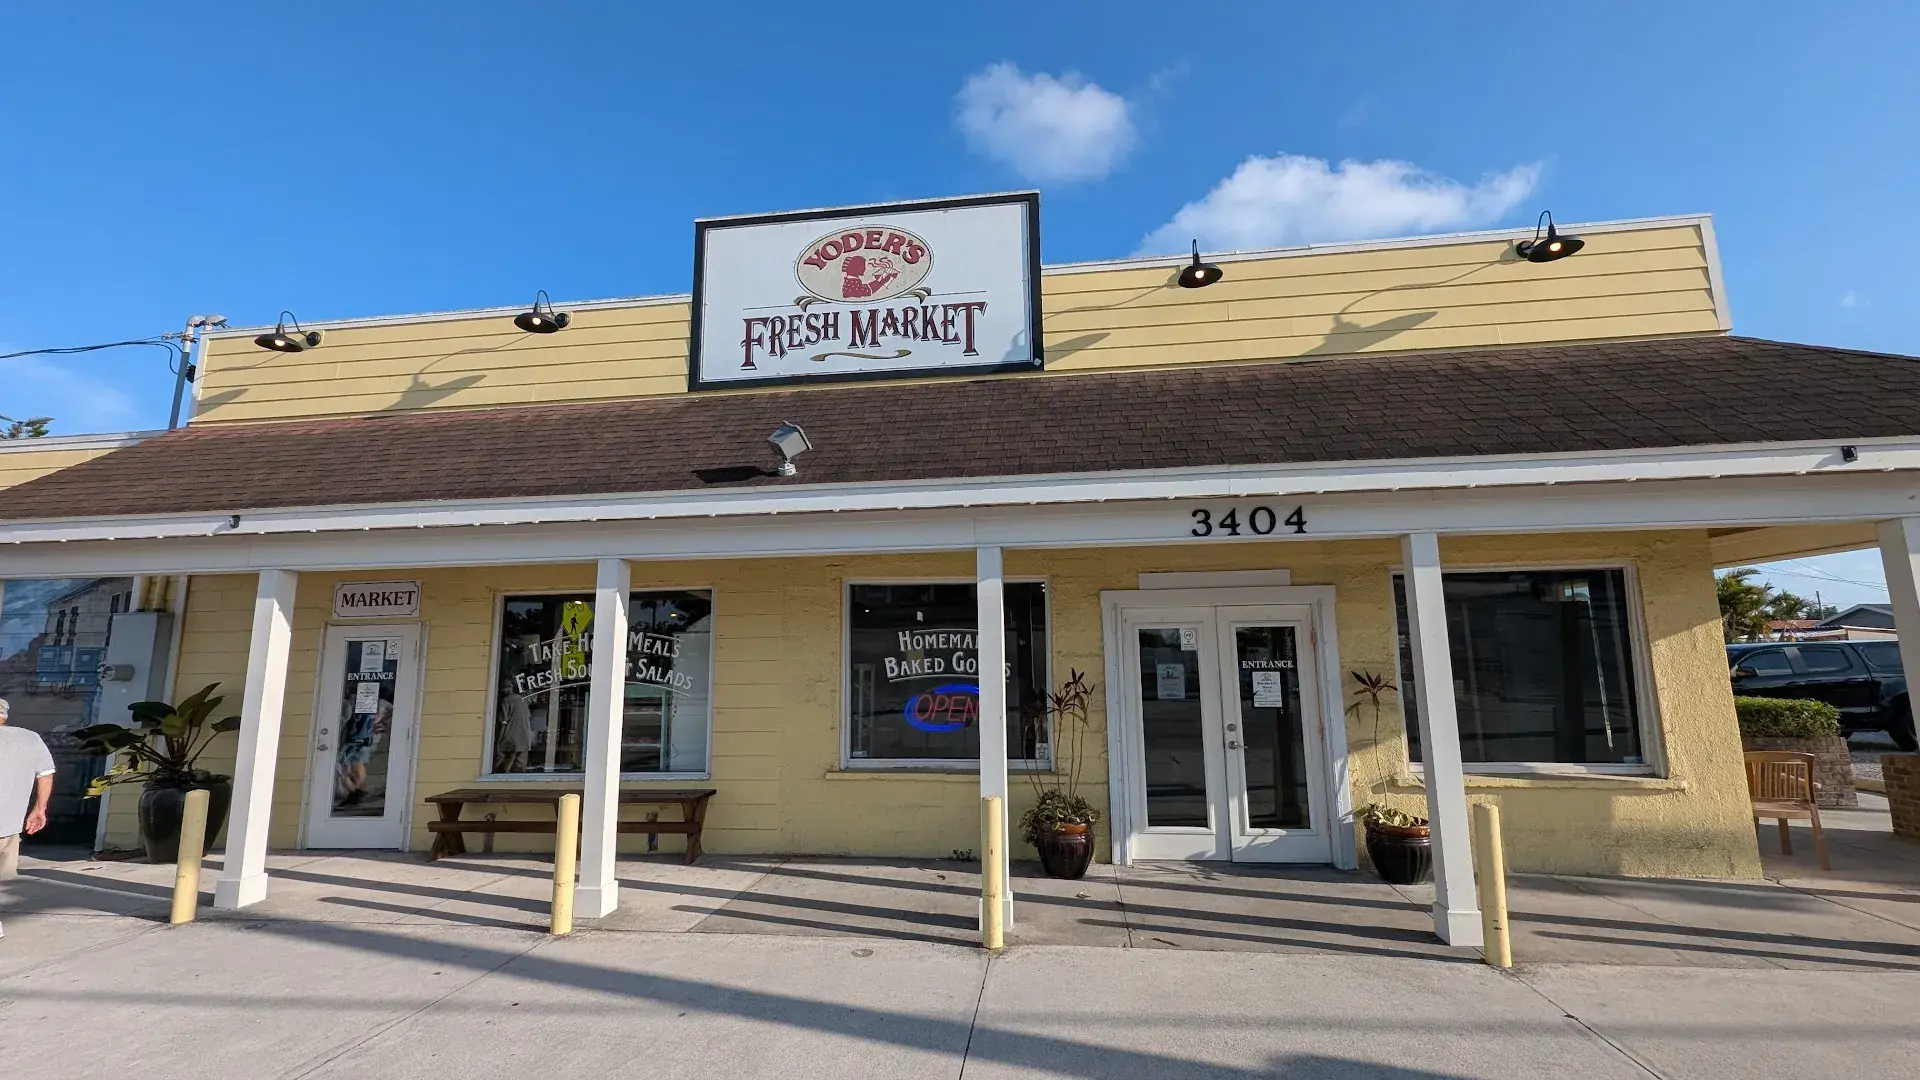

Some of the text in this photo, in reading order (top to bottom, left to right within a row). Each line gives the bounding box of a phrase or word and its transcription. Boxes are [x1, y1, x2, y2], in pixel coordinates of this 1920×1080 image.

[803, 230, 925, 271] YODER'S
[740, 301, 988, 371] FRESH MARKET
[1191, 505, 1308, 537] 3404
[340, 590, 416, 608] MARKET
[528, 639, 572, 665] TAKE
[628, 631, 682, 658] MEALS
[347, 671, 394, 681] ENTRANCE
[515, 666, 563, 694] FRESH
[636, 658, 694, 690] SALADS
[884, 651, 1011, 678] BAKED GOS
[1242, 660, 1295, 669] ENTRANCE
